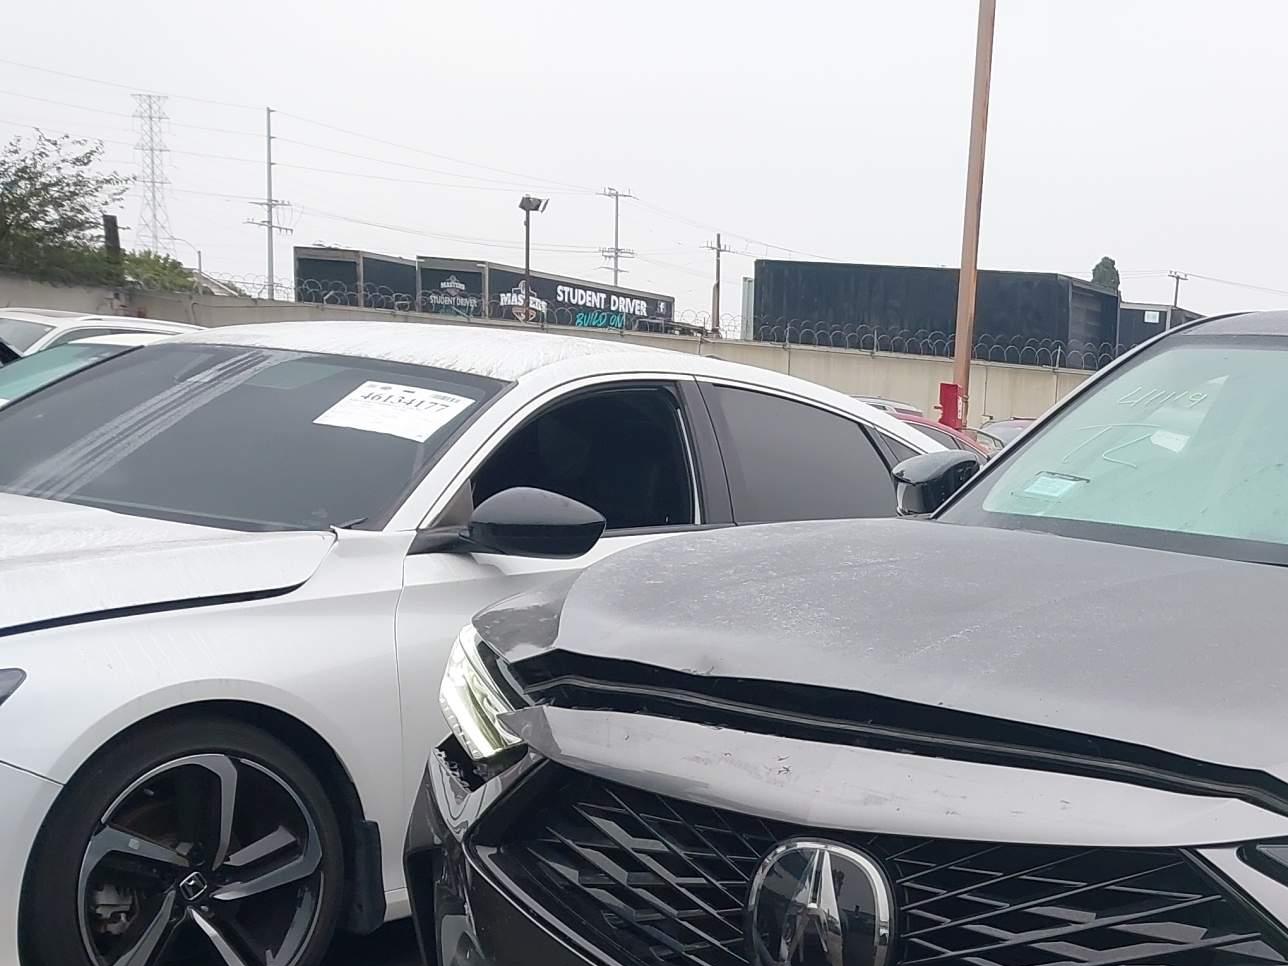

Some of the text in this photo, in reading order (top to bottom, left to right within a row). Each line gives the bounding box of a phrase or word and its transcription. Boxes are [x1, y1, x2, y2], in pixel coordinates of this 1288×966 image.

[430, 294, 478, 308] STUDENT DRIVER
[500, 292, 548, 312] MASERS
[556, 285, 648, 317] STUDENT DRIVER
[575, 312, 625, 328] BUILD ON
[360, 391, 450, 413] 46134177
